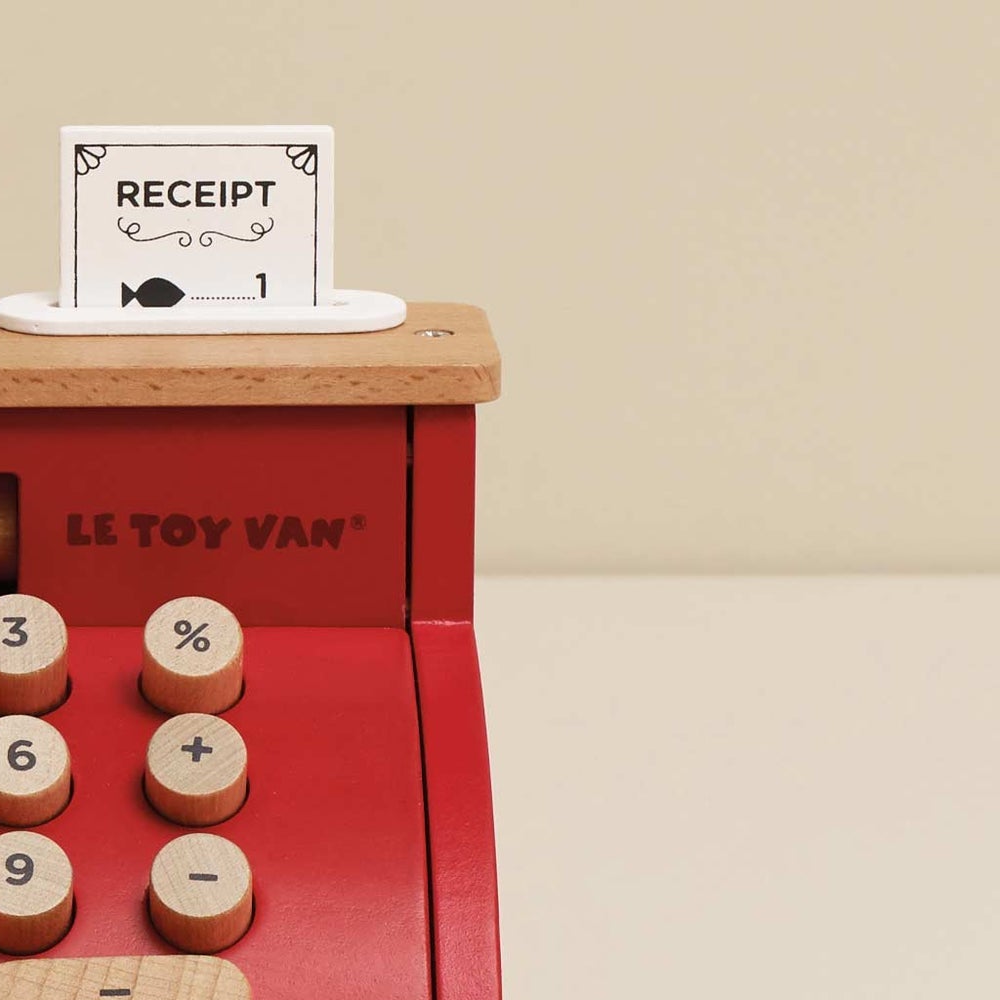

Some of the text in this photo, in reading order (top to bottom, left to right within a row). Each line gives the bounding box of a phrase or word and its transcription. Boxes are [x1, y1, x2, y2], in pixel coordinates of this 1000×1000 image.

[117, 180, 277, 208] RECEIPT
[66, 513, 117, 546] LE
[129, 513, 232, 550] TOY
[2, 617, 28, 647] 3
[173, 620, 211, 652] %
[7, 740, 37, 771] 6
[181, 737, 213, 762] +
[5, 853, 35, 886] 9
